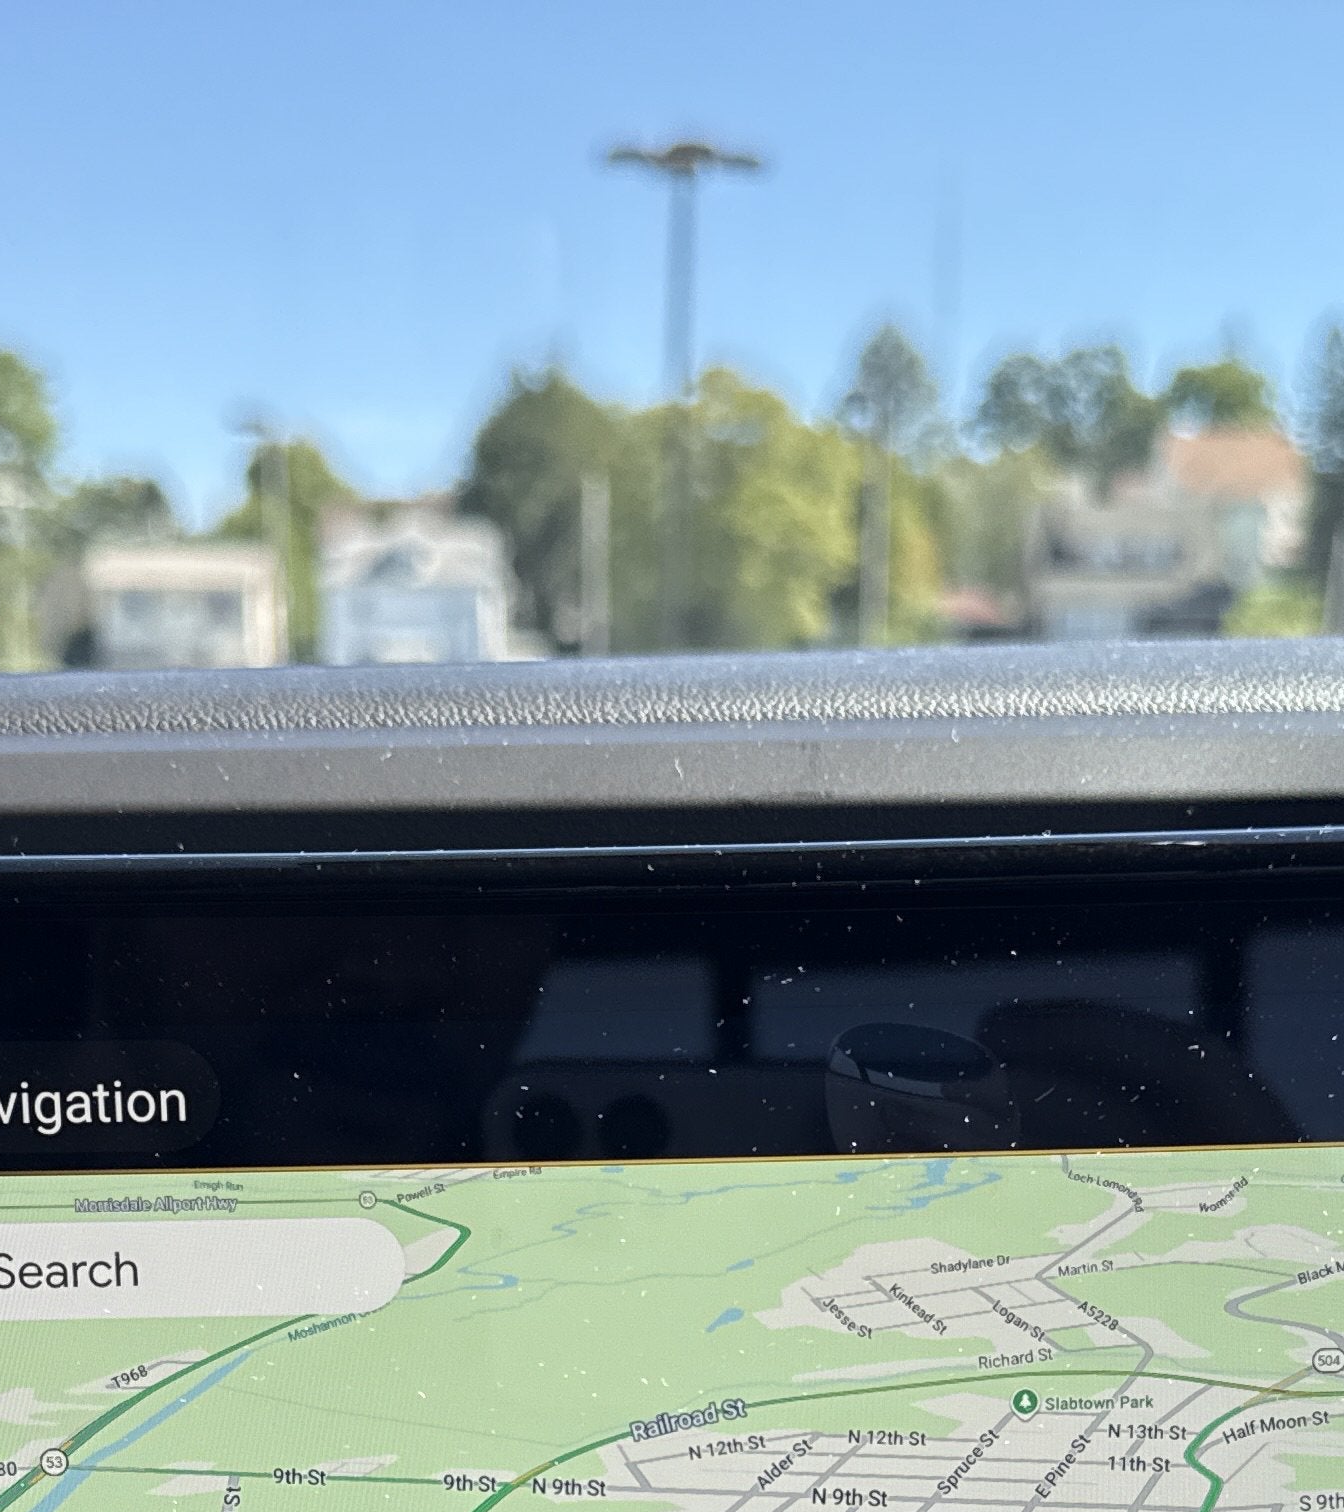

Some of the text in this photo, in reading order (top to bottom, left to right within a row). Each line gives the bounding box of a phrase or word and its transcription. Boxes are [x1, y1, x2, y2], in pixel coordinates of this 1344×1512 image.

[1068, 1170, 1093, 1184] Loch
[1096, 1176, 1137, 1198] Lomond
[397, 1186, 430, 1204] Powell
[74, 1196, 237, 1214] Morrisdale Allport Hwy
[931, 1256, 1010, 1275] Shadylane Dr
[1058, 1260, 1114, 1278] Martin St
[1297, 1265, 1334, 1285] Black
[889, 1283, 948, 1336] Kinkead St
[1077, 1300, 1120, 1331] A5228
[287, 1312, 356, 1342] Moshannon
[992, 1300, 1046, 1342] Logan St
[978, 1348, 1053, 1369] Richard St
[1317, 1354, 1341, 1368] 504
[111, 1365, 149, 1389] T968
[1045, 1394, 1154, 1412] Slabtown Park
[630, 1399, 748, 1442] Railroad St
[1222, 1410, 1330, 1444] Half Moon St
[848, 1430, 926, 1446] N 12th St
[1108, 1424, 1187, 1440] N 13th St
[45, 1455, 64, 1469] 53
[937, 1429, 1000, 1496] Spruce St
[1108, 1455, 1171, 1473] 11th St
[273, 1468, 327, 1487] 9th St
[225, 1486, 241, 1507] St
[812, 1489, 888, 1508] N 9th St
[1299, 1495, 1312, 1511] S
